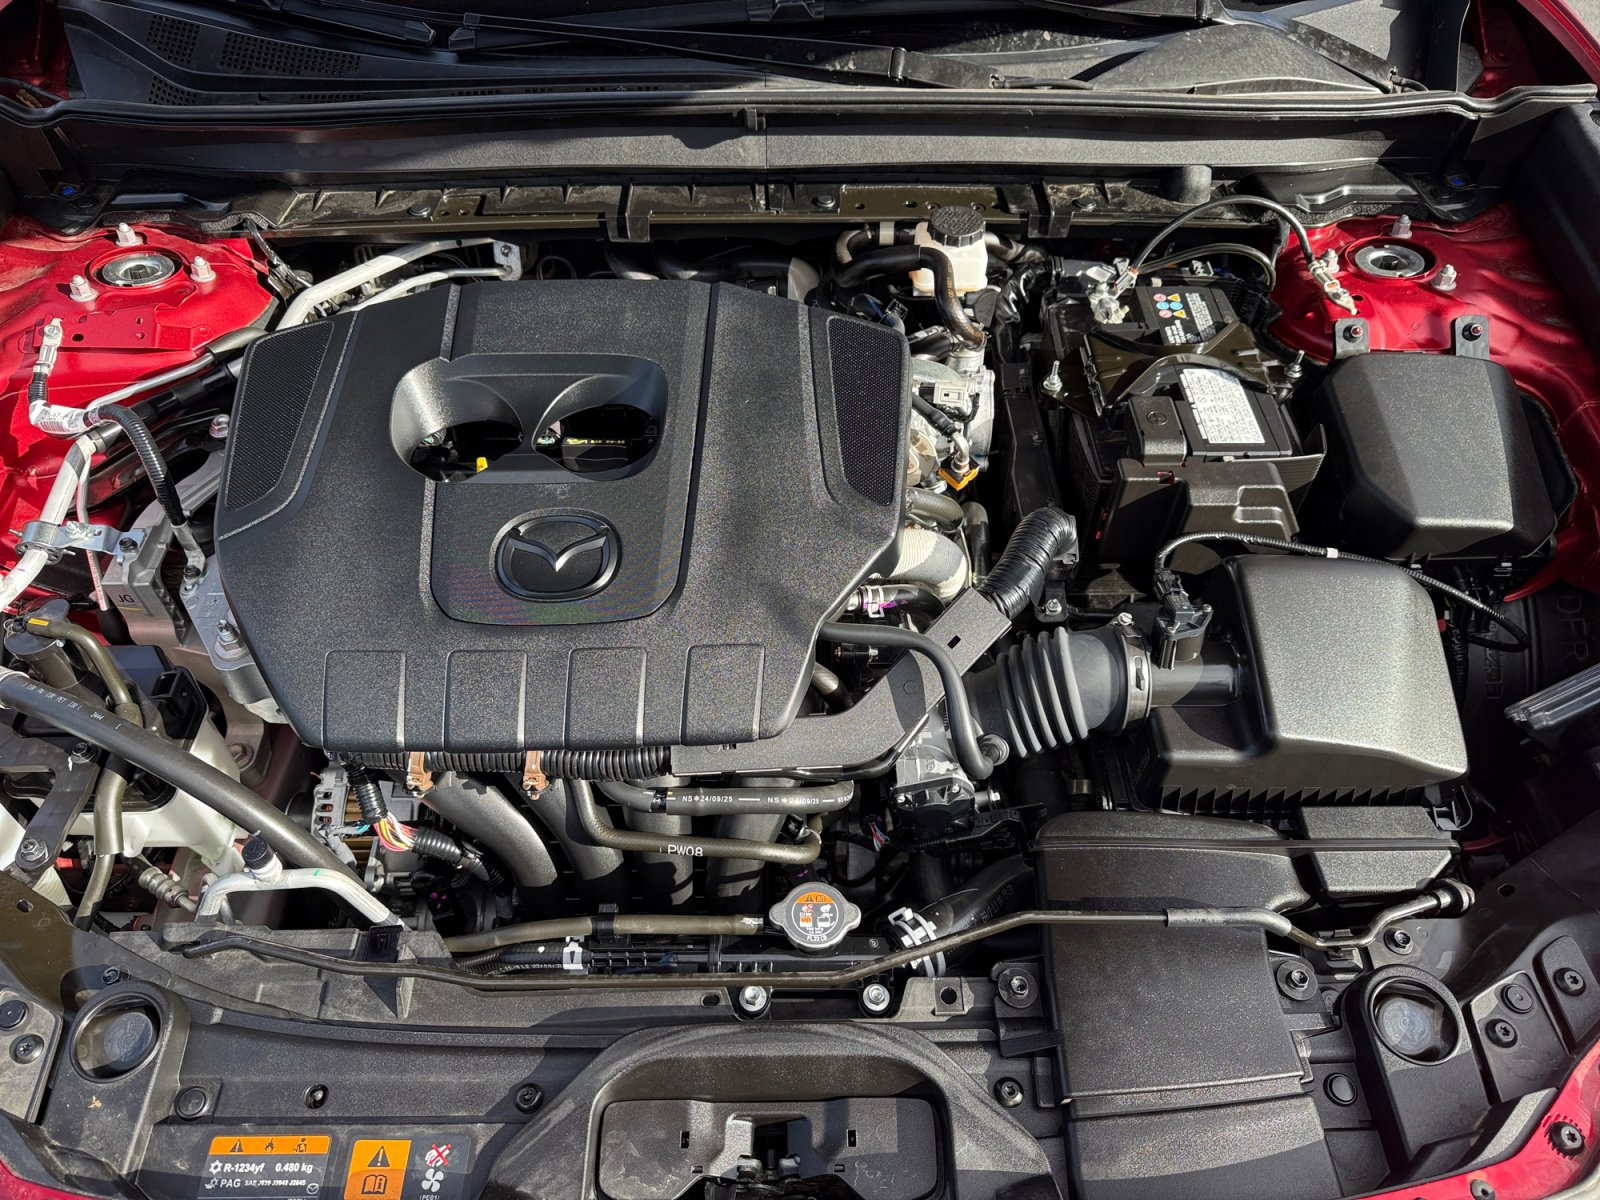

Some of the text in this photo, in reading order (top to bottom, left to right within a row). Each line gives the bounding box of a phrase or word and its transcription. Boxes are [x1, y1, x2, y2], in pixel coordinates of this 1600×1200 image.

[223, 1162, 314, 1175] R-1234yf 0.480 kg
[219, 1178, 241, 1188] PAG
